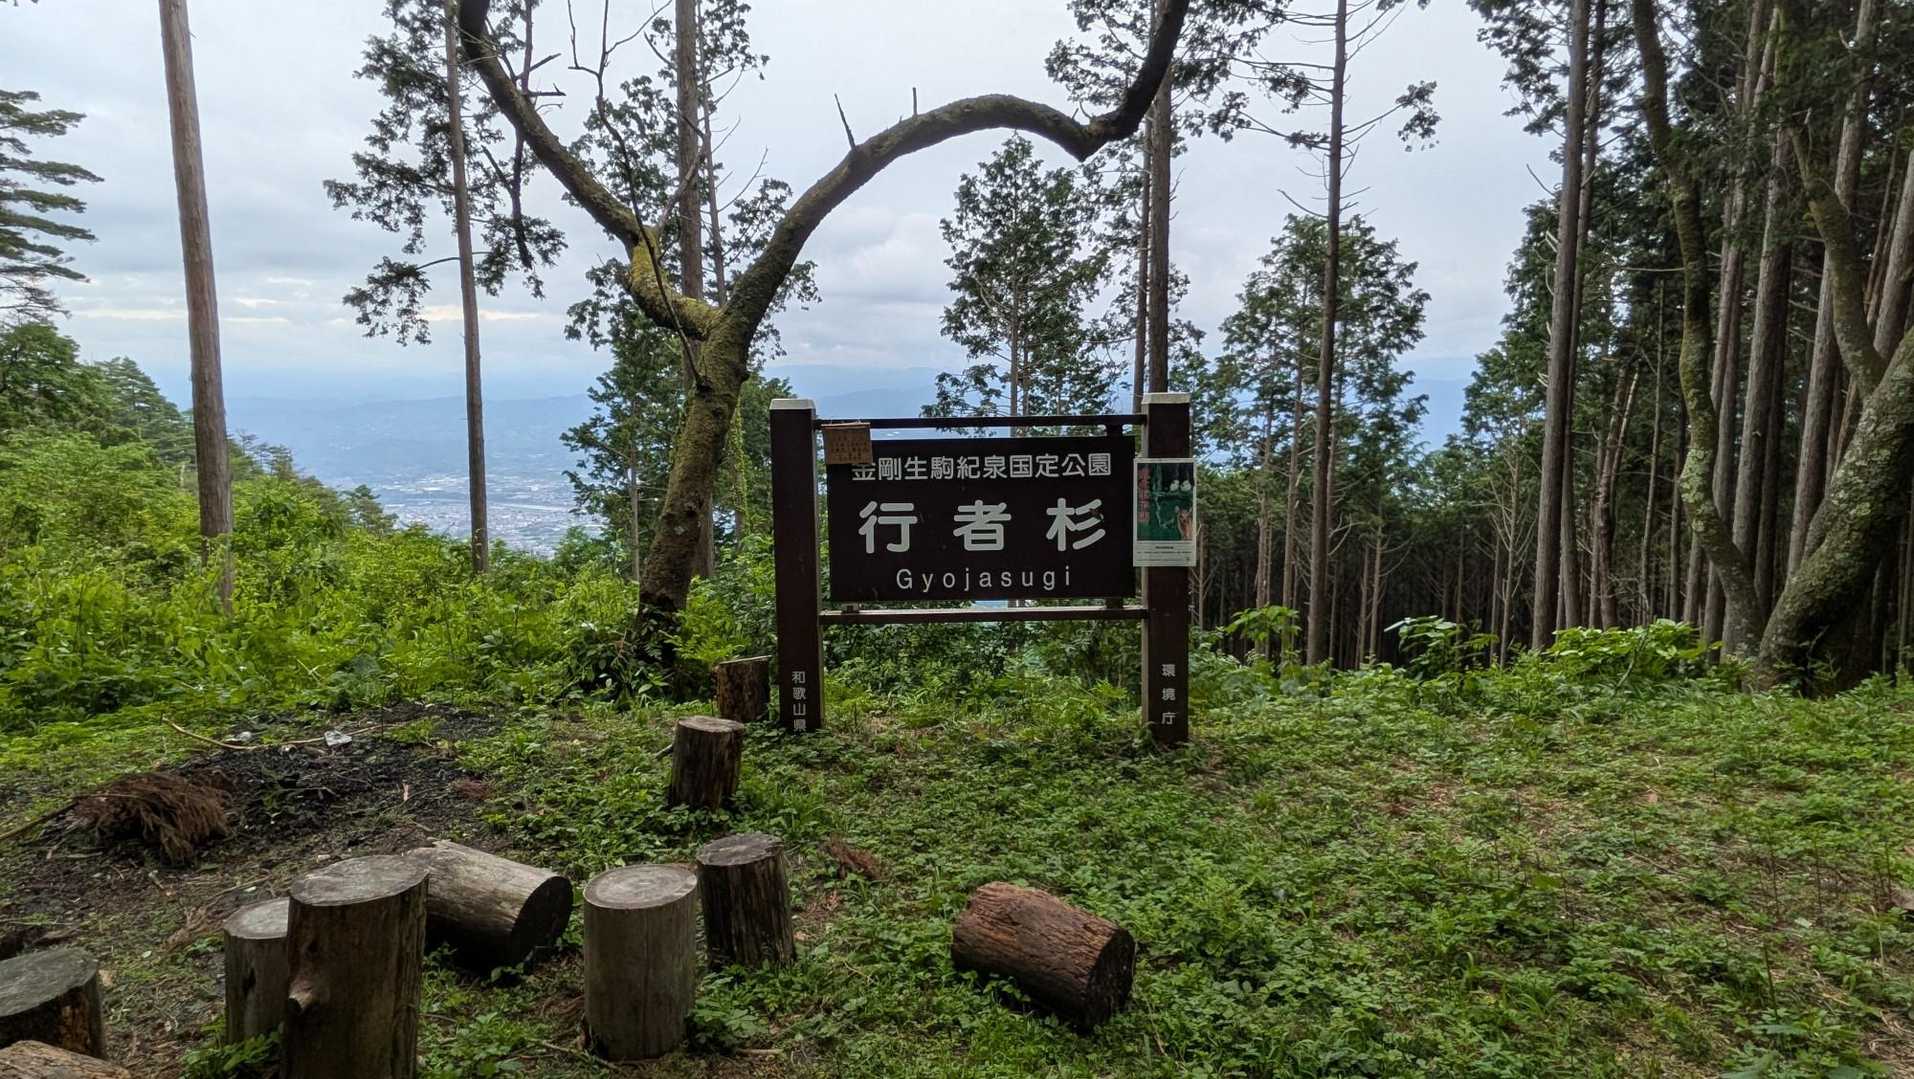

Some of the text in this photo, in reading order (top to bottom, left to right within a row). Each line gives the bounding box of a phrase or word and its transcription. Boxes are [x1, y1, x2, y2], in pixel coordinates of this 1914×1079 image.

[852, 453, 1111, 481] 金剛生駒紀泉国定公園
[858, 498, 1106, 554] 行者杉
[896, 565, 1071, 593] Gyojasugi
[791, 671, 807, 732] 和歌山県
[1161, 663, 1177, 725] 環境庁
